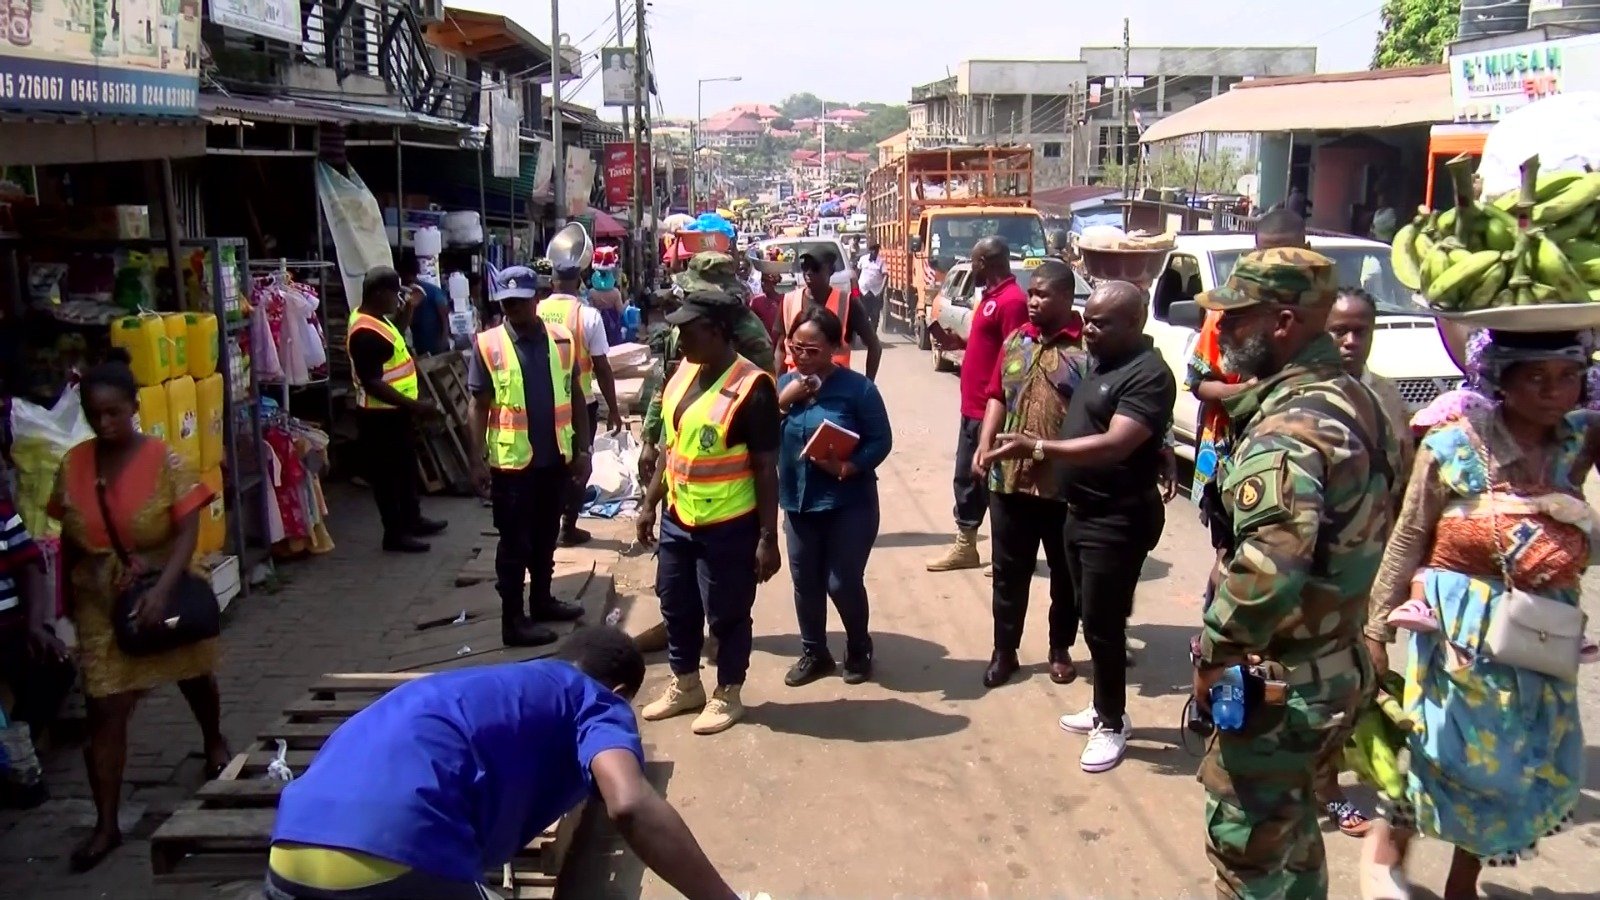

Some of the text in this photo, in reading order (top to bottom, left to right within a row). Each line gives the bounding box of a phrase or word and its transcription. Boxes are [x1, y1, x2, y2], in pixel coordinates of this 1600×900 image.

[19, 74, 63, 100] 276067
[70, 78, 98, 102] 0545
[102, 81, 137, 104] 851758
[142, 85, 164, 106] 0244
[608, 167, 632, 178] Taste
